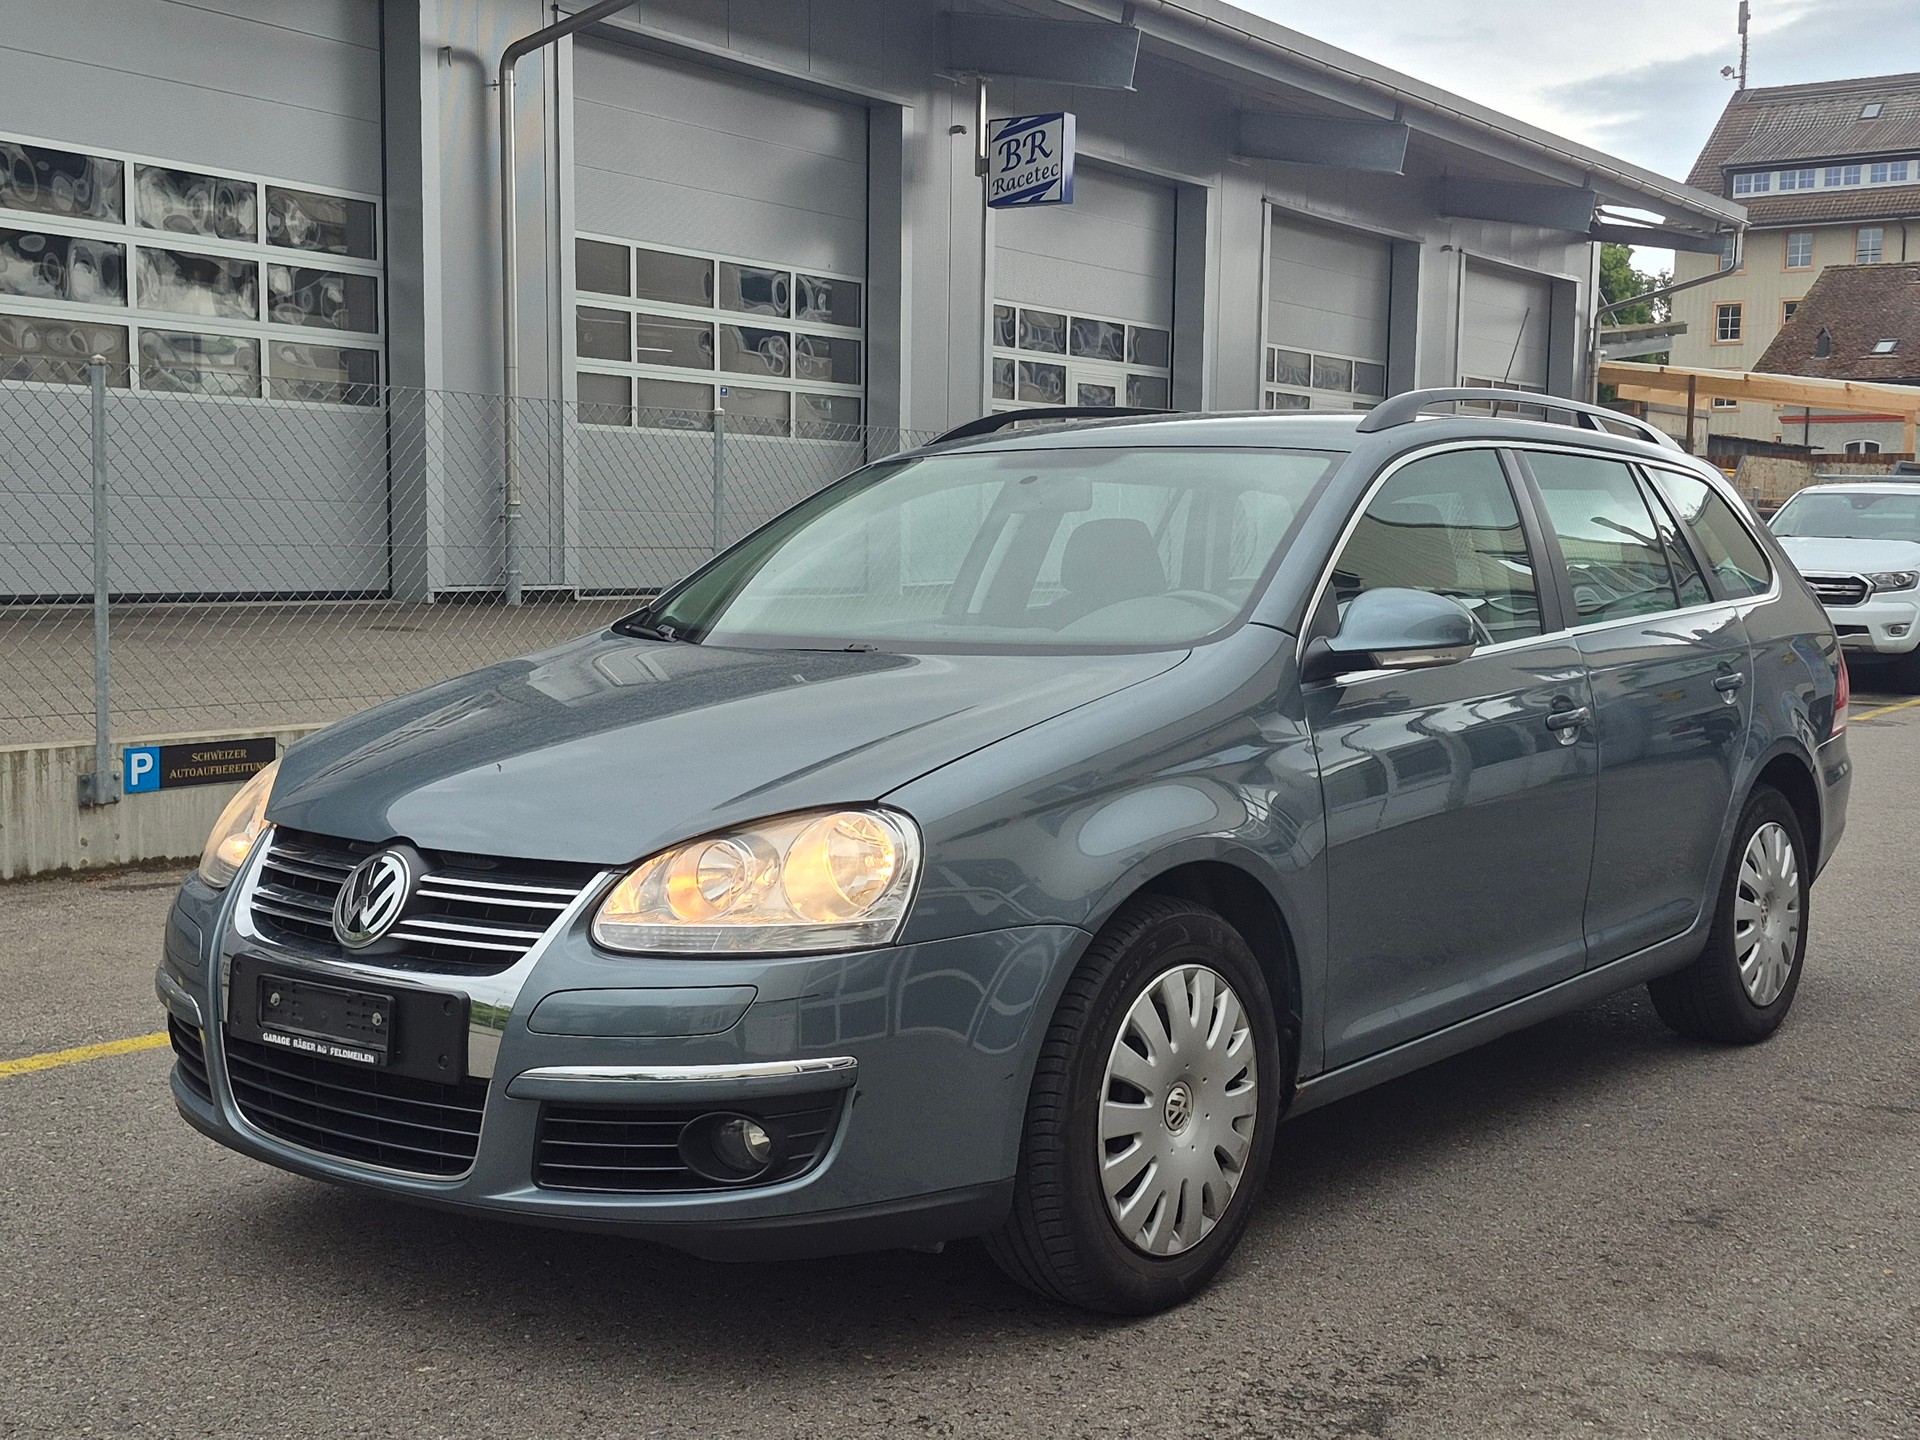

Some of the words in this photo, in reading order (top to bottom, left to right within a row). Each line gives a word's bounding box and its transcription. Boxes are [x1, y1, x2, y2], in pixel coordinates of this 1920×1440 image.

[998, 129, 1053, 173] BR
[992, 163, 1059, 196] Racetec
[131, 752, 154, 786] P
[191, 749, 248, 763] SCHWEIZER
[262, 1032, 291, 1046] GARAGE
[329, 1046, 375, 1064] FELDMEILEN
